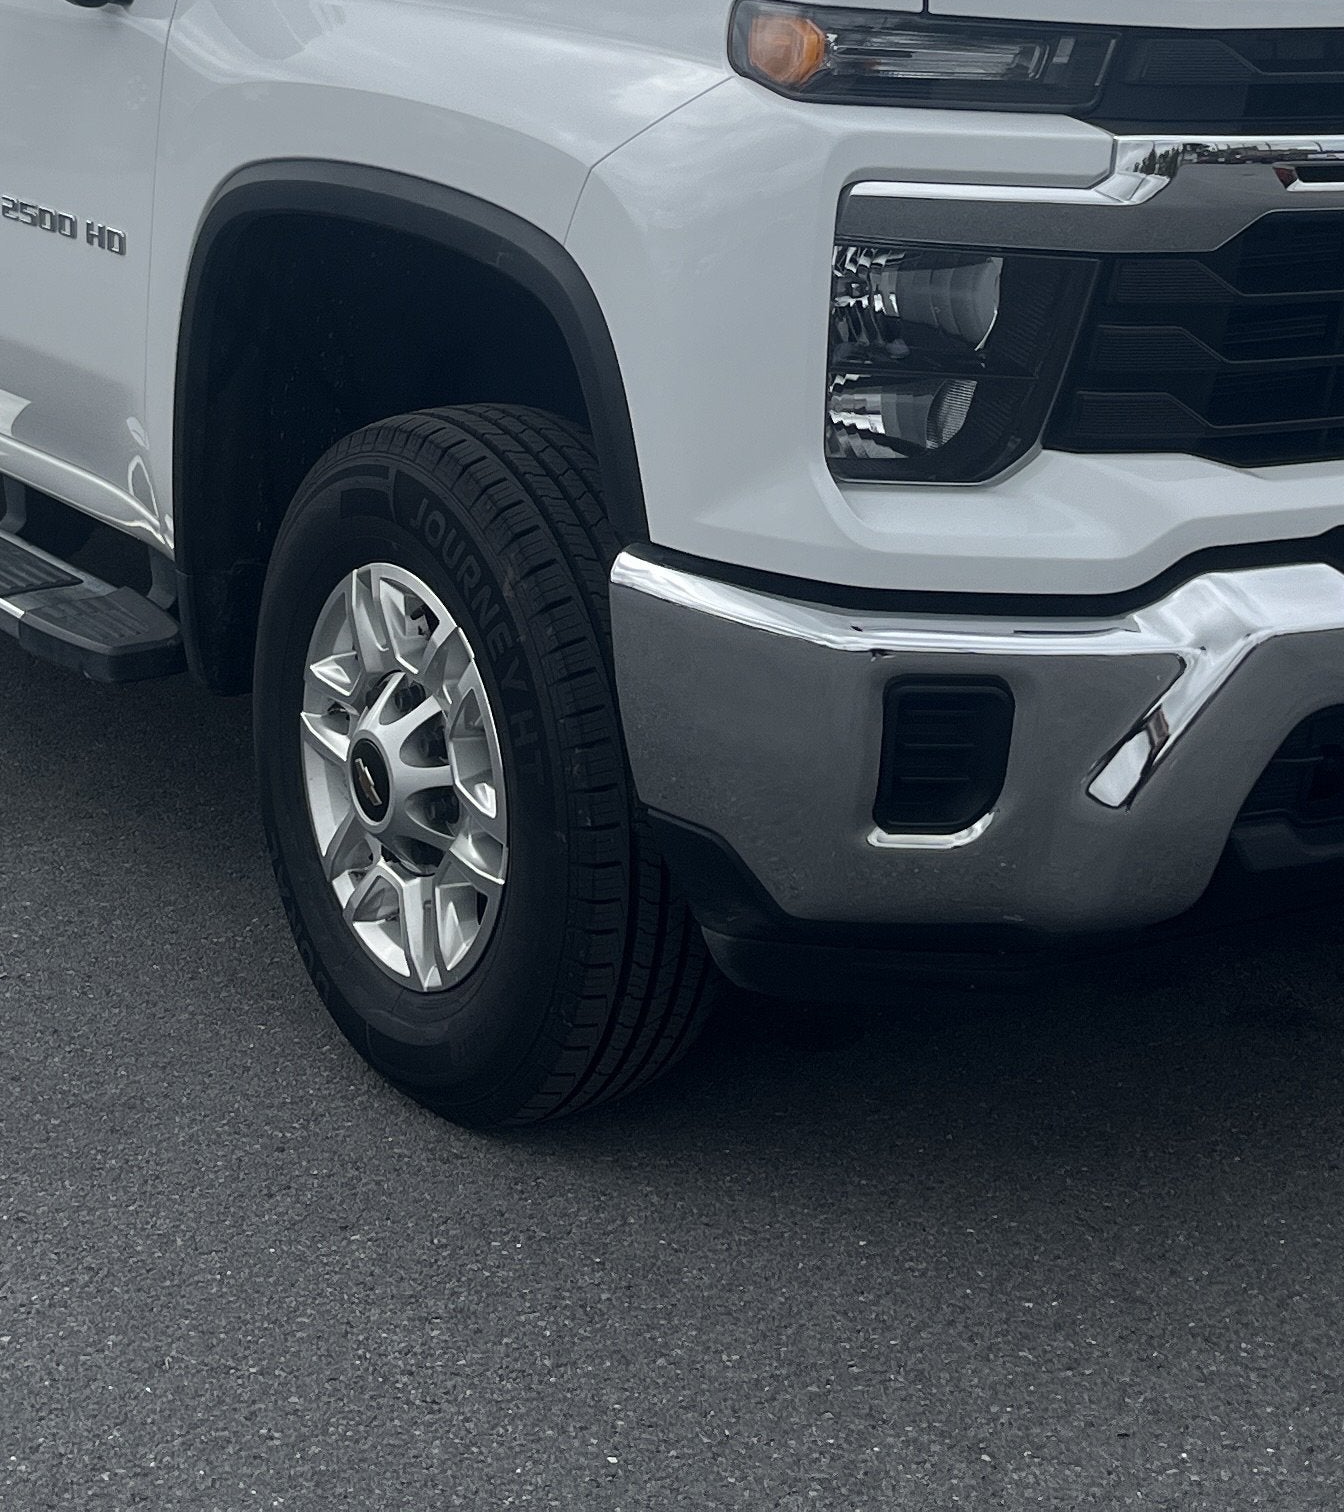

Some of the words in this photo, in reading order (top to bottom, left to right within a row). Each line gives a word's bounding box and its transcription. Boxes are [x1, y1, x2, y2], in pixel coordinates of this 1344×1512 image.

[1, 193, 78, 239] 2500
[85, 219, 127, 256] HD
[410, 496, 530, 691] JOURNEY
